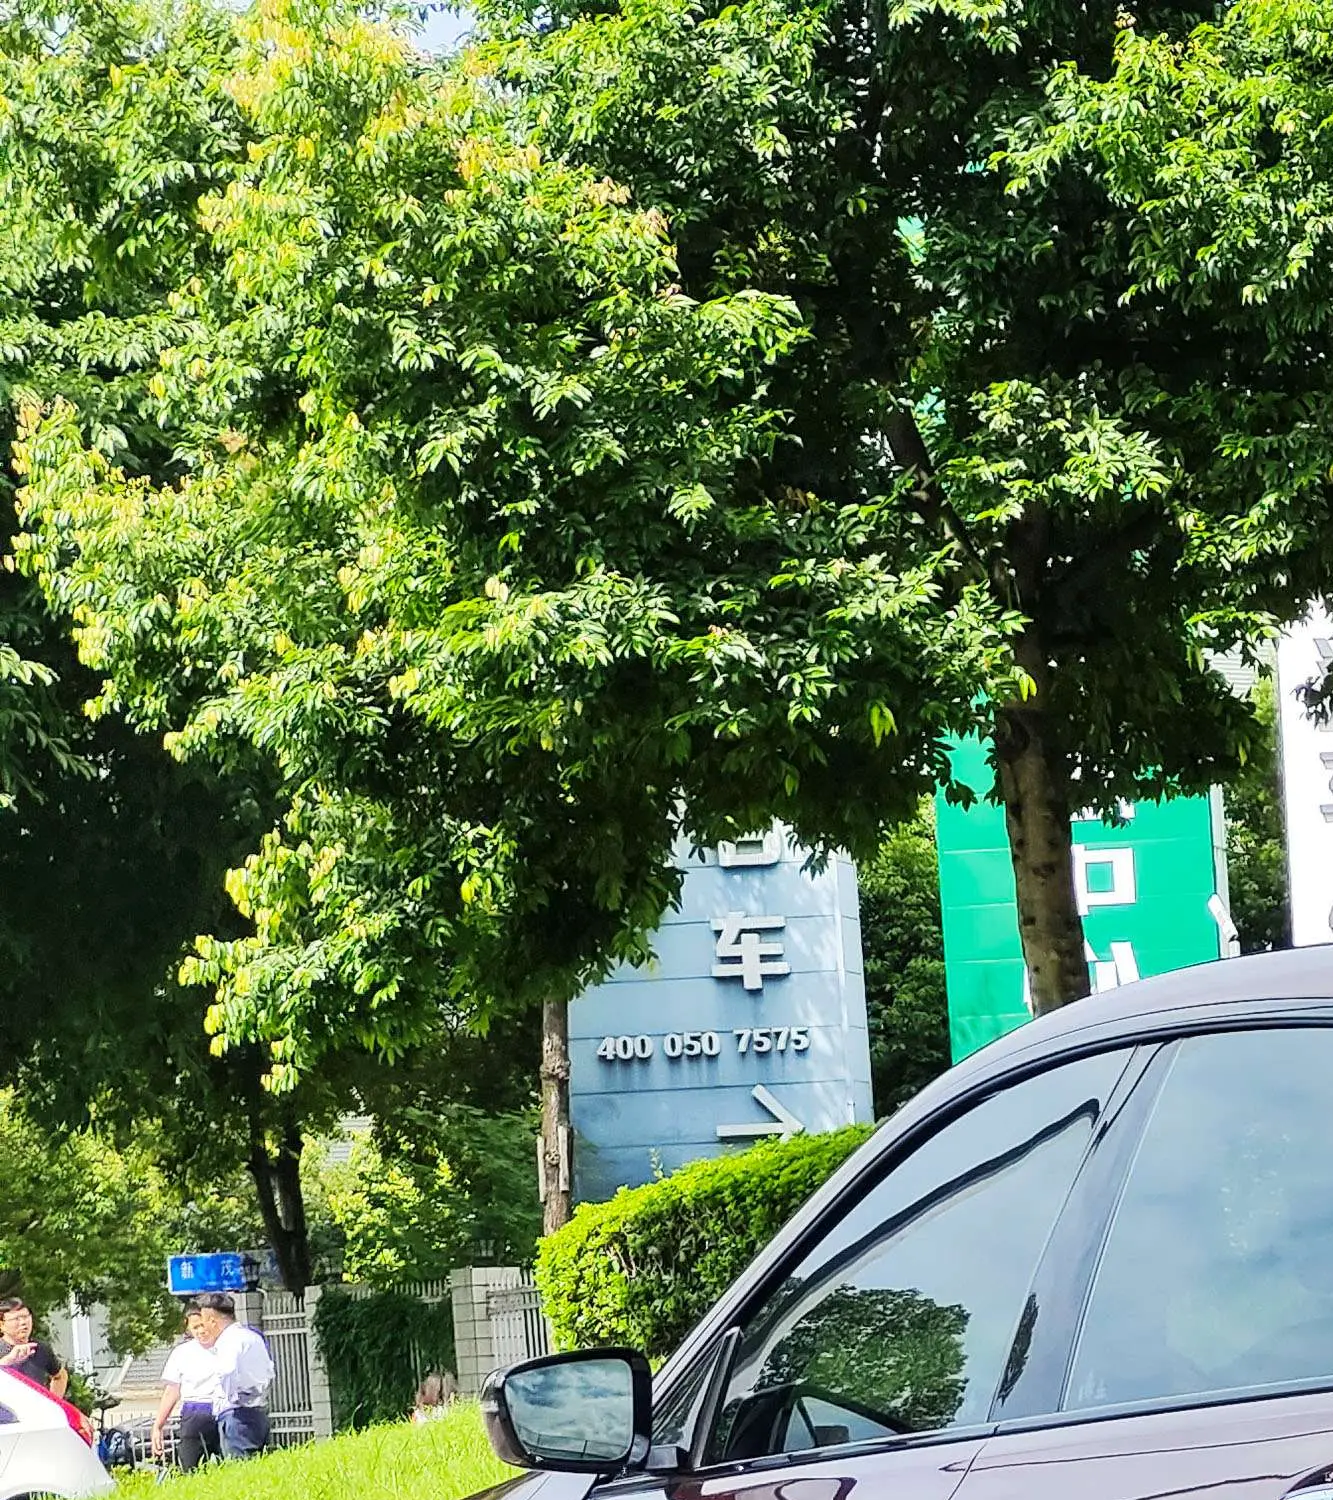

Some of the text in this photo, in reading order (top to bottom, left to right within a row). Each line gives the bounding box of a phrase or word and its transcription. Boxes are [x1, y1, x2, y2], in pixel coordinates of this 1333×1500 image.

[597, 1026, 810, 1060] 400 050 7575
